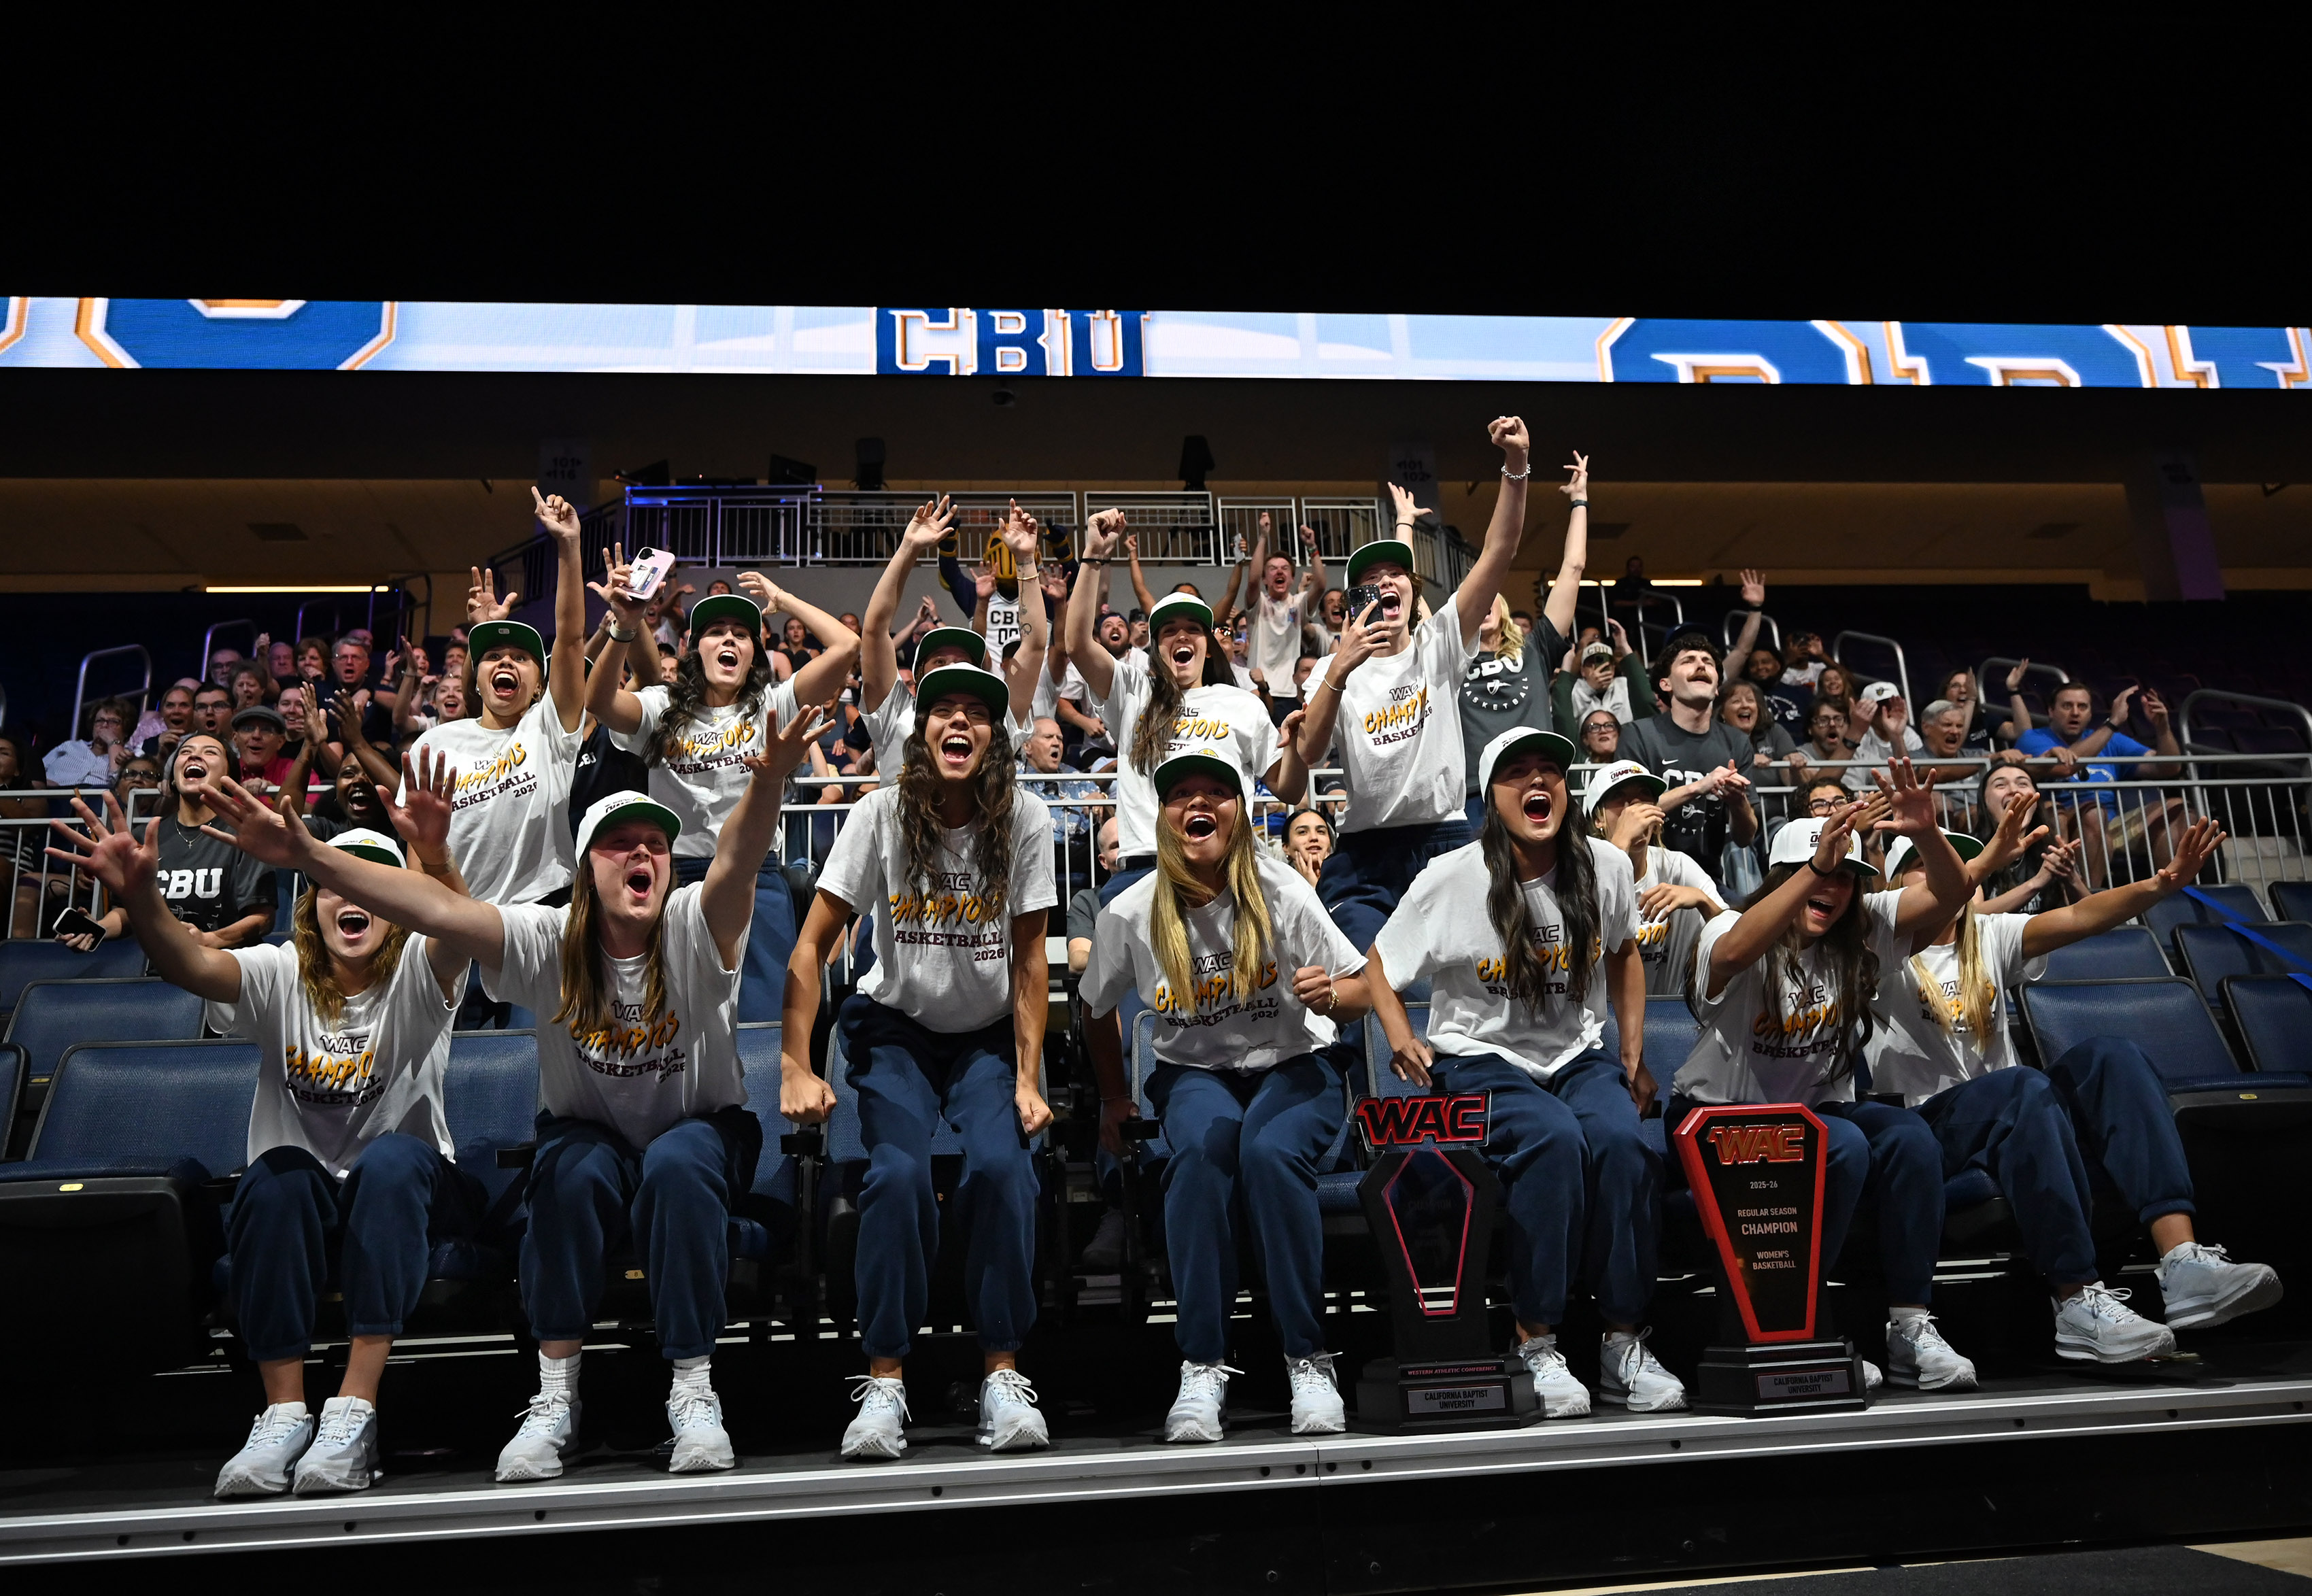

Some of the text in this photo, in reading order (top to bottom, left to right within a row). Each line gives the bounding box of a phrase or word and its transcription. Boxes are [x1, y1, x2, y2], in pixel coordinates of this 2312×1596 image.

[1463, 677, 1529, 711] BASKETBALL
[452, 771, 535, 812] ASKETBALL
[941, 872, 971, 891] AC
[895, 930, 1004, 948] ASKETBALL
[1533, 924, 1560, 945] AC
[974, 948, 1005, 962] 2026
[612, 1000, 644, 1022] WA
[320, 1034, 369, 1054] WAC
[1357, 1093, 1486, 1144] WAC
[1707, 1123, 1805, 1166] WAC
[1750, 1181, 1778, 1189] 2025-26
[1737, 1207, 1797, 1217] REGULAR SEASON
[1741, 1221, 1798, 1235] CHAMPION
[1756, 1251, 1789, 1259] WOMEN'S
[1752, 1260, 1796, 1270] BASKETBALL
[1773, 1374, 1833, 1386] CALIFORNIA BAPTIST
[1425, 1390, 1488, 1401] CALIFORNIA BAPTIST
[1788, 1385, 1822, 1394] UNIVERSITY
[1439, 1400, 1475, 1409] UNIVERSITY
